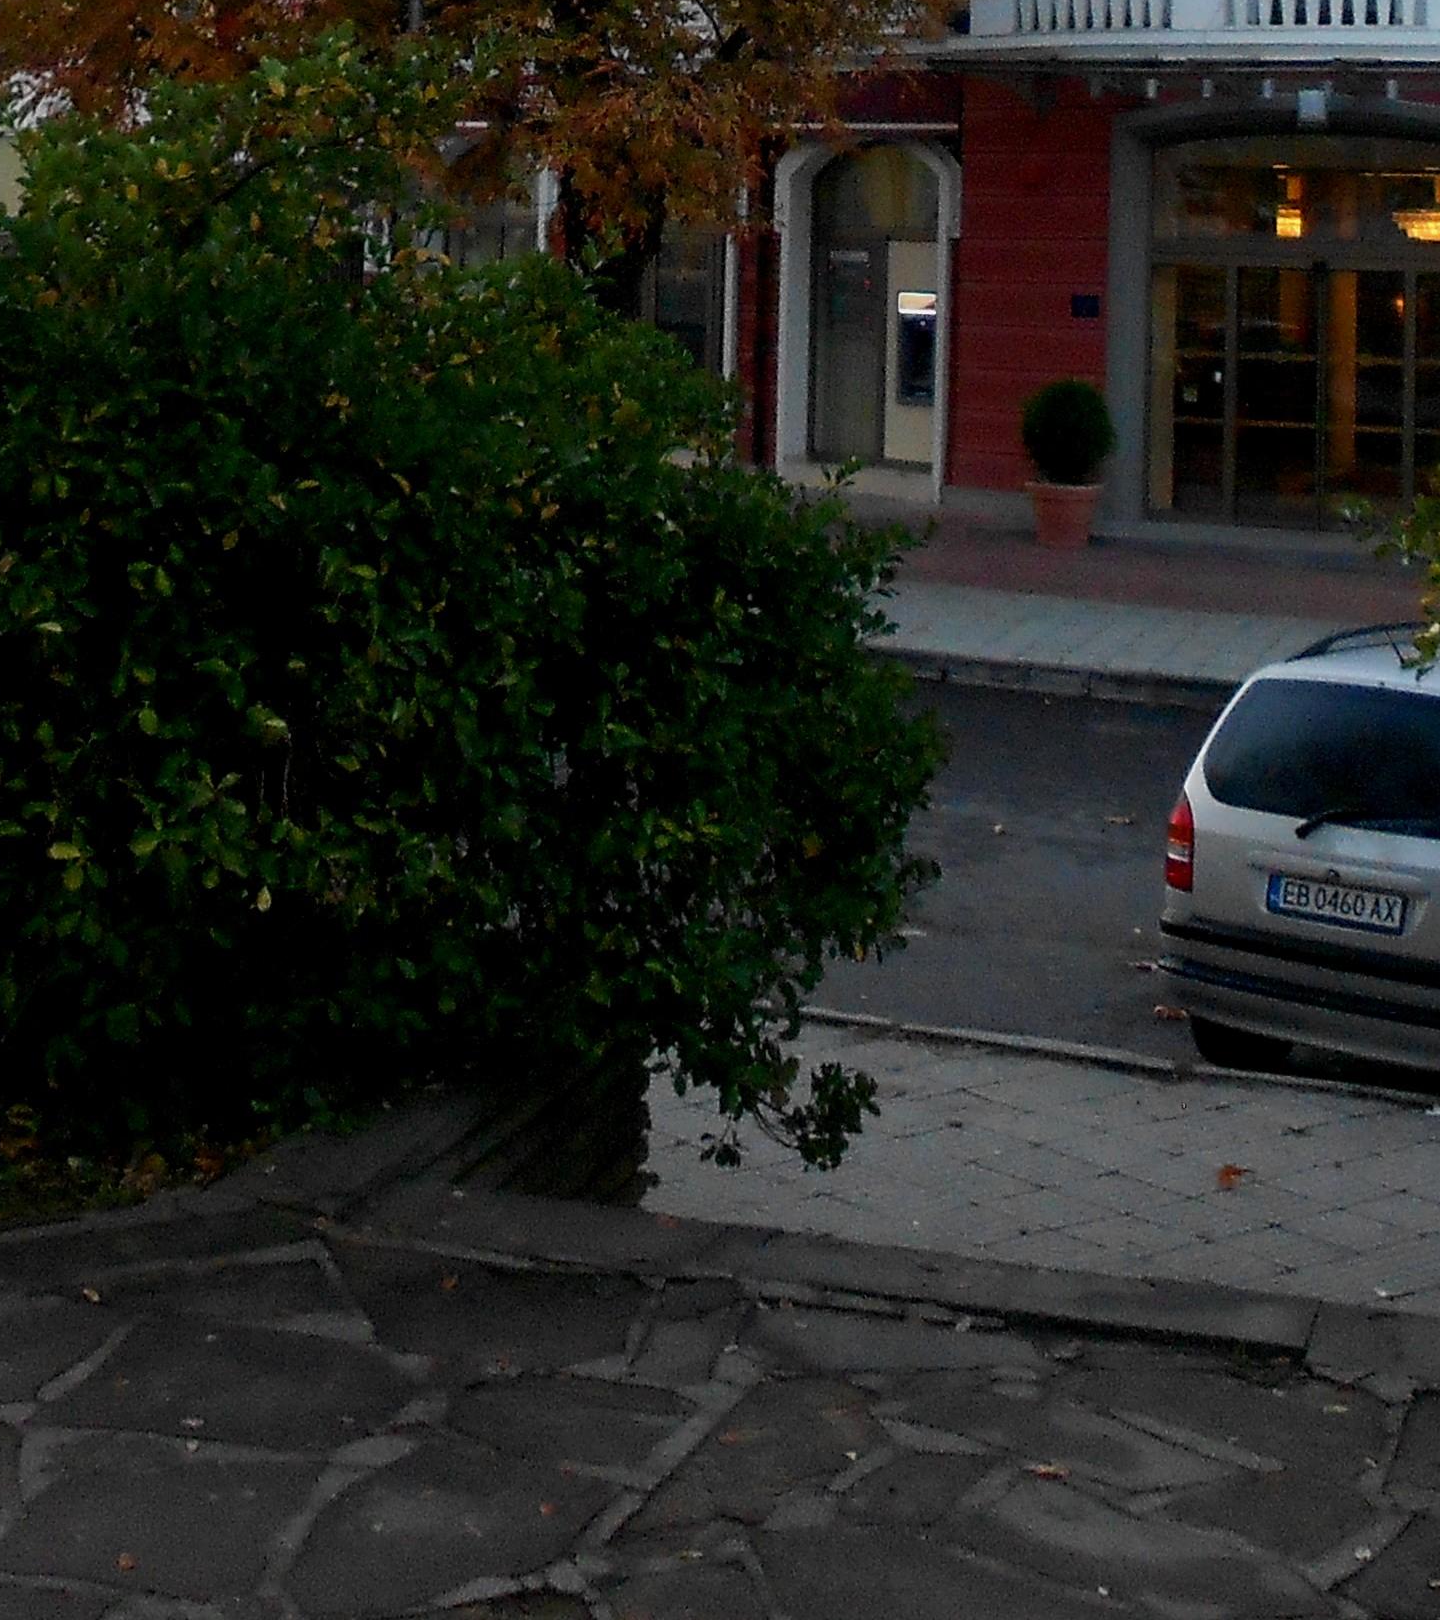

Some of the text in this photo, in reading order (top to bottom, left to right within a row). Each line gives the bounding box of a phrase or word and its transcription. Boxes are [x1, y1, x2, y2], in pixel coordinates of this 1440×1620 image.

[1283, 882, 1398, 922] EB 0460 AX
